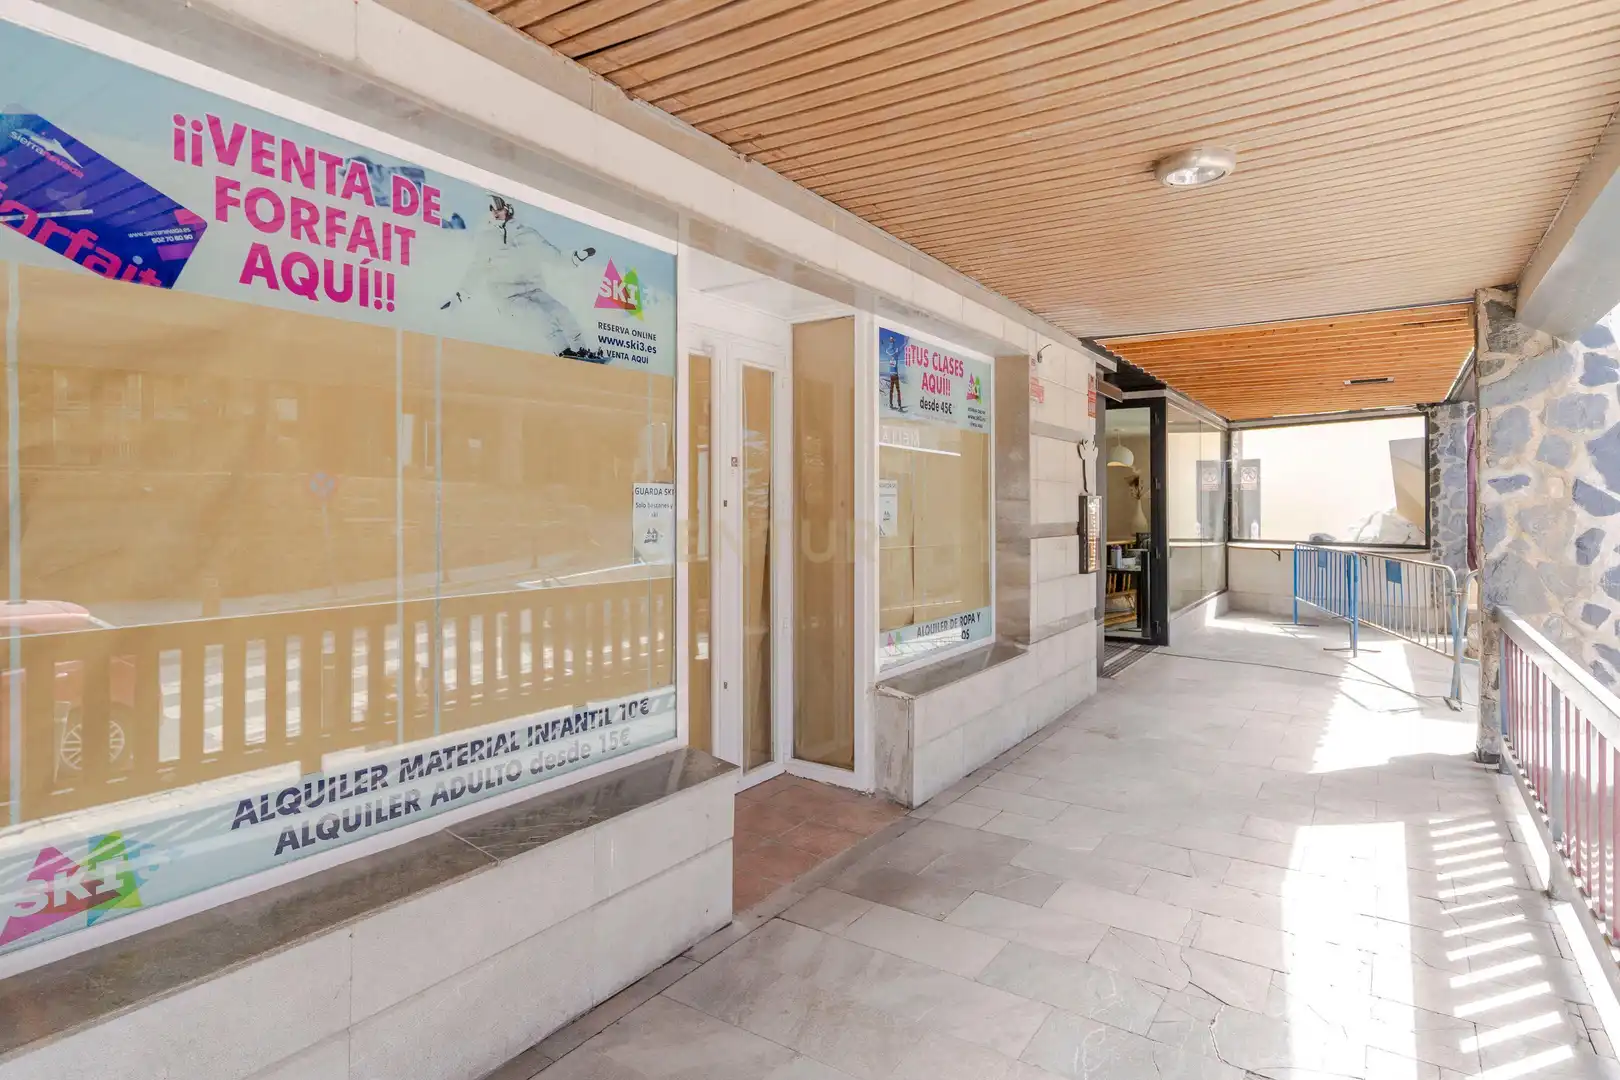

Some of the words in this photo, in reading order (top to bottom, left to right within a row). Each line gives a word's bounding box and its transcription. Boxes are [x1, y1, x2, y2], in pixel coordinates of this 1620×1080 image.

[172, 111, 375, 208] ¡¡VENTA
[392, 175, 441, 227] DE
[215, 175, 416, 267] FORFAIT
[239, 241, 396, 313] AQUÍ!!
[597, 321, 630, 335] RESERVA
[631, 329, 657, 341] ONLINE
[597, 334, 657, 354] www.ski3.es
[606, 350, 630, 361] VENTA
[932, 351, 964, 378] CLASES
[919, 395, 940, 413] desde
[940, 401, 953, 415] 45€
[634, 487, 663, 496] GUARDA
[917, 620, 948, 638] ALQUILER
[949, 617, 959, 630] DE
[959, 612, 976, 627] ROPA
[976, 611, 982, 623] Y
[230, 763, 389, 831] ALQUILER
[398, 730, 521, 783] MATERIAL
[527, 707, 613, 748] INFANTIL
[619, 697, 650, 721] 10€
[273, 788, 422, 856] ALQUILER
[430, 759, 523, 807] ADULTO
[529, 739, 592, 775] desde
[599, 726, 632, 754] 15€
